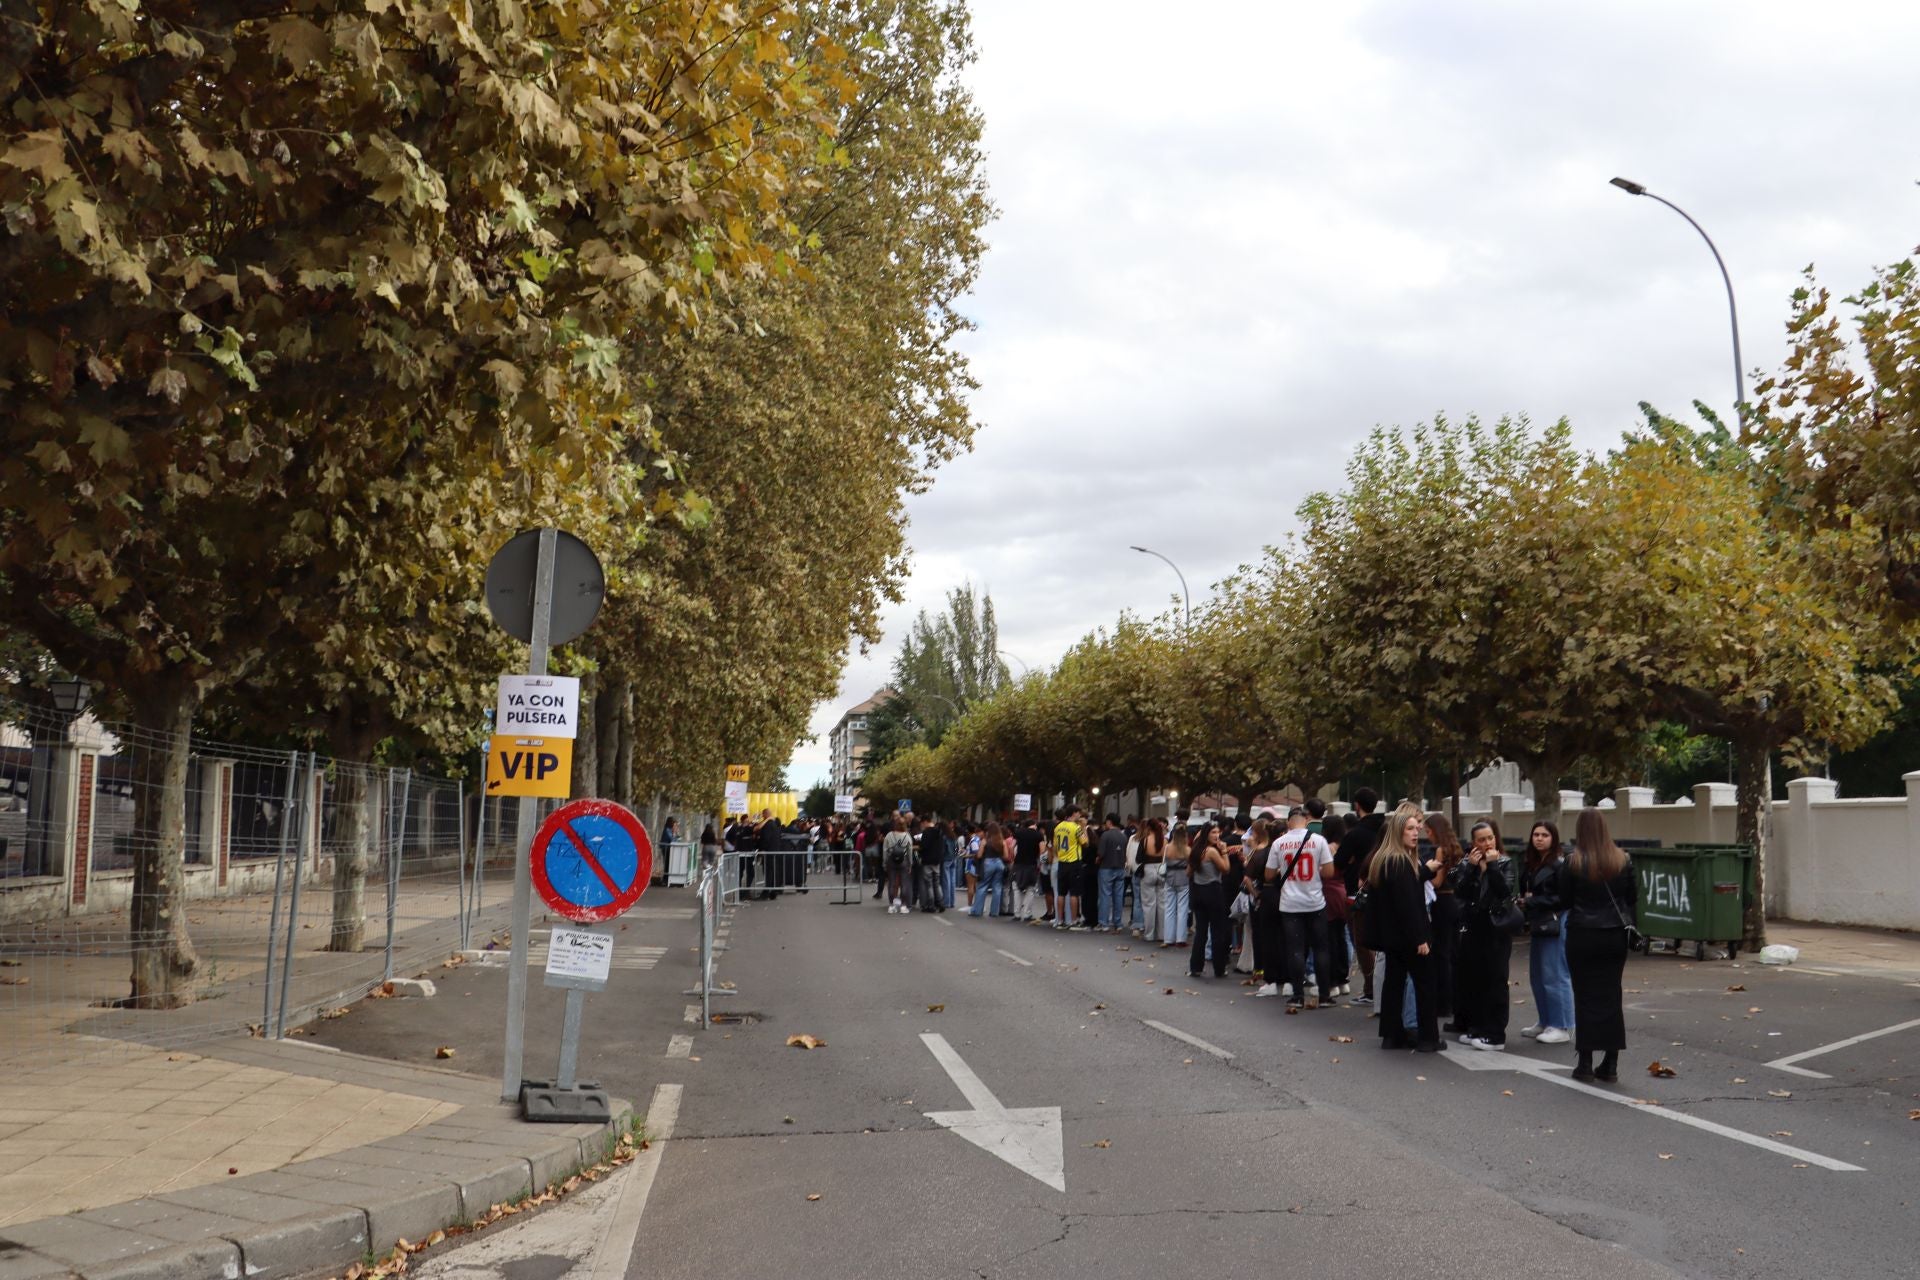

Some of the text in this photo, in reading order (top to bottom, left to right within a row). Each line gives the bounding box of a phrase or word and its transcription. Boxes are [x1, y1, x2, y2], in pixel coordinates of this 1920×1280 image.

[508, 694, 564, 708] YA CON
[506, 711, 567, 726] PULSERA
[500, 751, 559, 781] VIP
[730, 769, 746, 778] VIP
[1056, 834, 1070, 852] 14
[1283, 852, 1315, 882] 10
[1641, 869, 1691, 913] VENA
